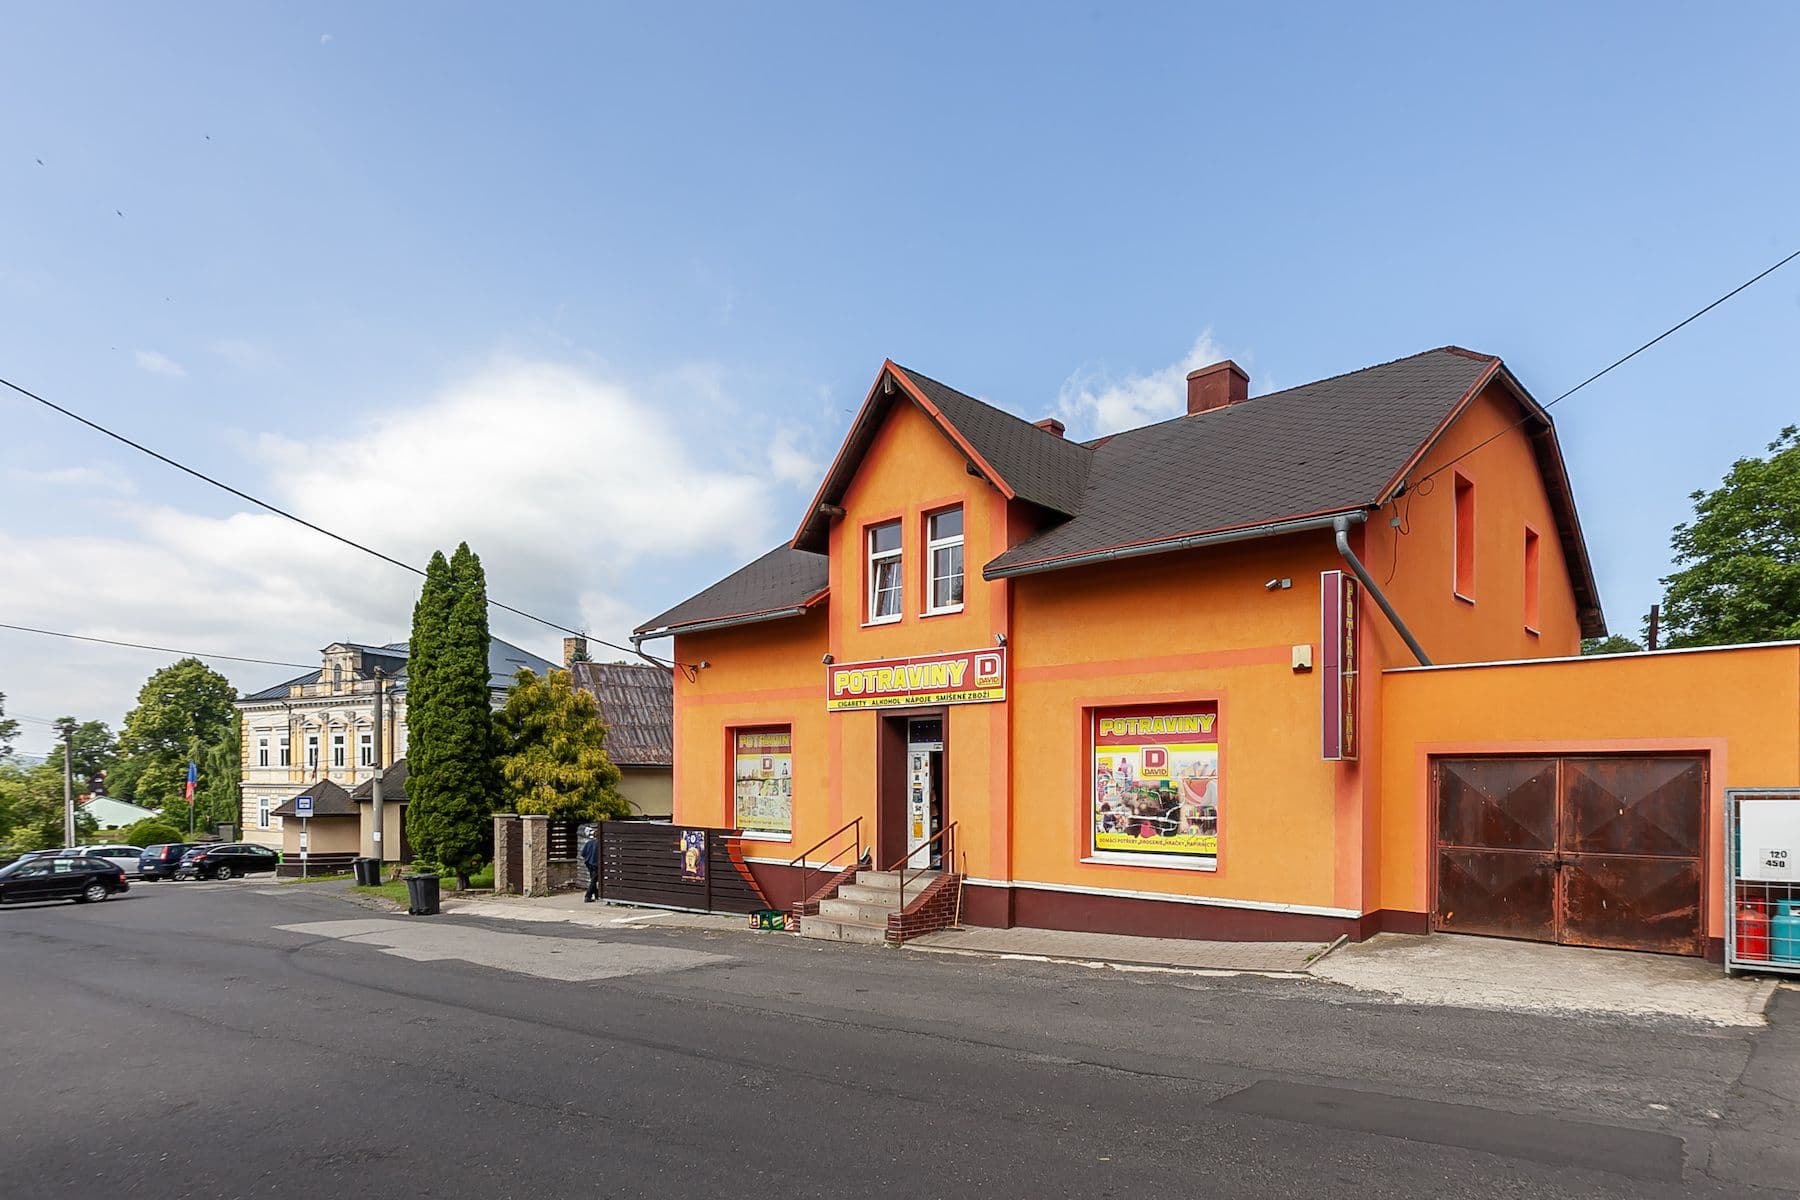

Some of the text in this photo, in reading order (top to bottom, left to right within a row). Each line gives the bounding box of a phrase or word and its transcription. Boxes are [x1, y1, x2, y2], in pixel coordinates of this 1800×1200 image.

[834, 659, 968, 696] POTRAVINY
[978, 677, 999, 685] DAVID
[872, 697, 900, 706] ALKOHOL
[1100, 714, 1216, 736] POTRAVINY
[1146, 750, 1165, 767] D
[1769, 850, 1787, 858] 120
